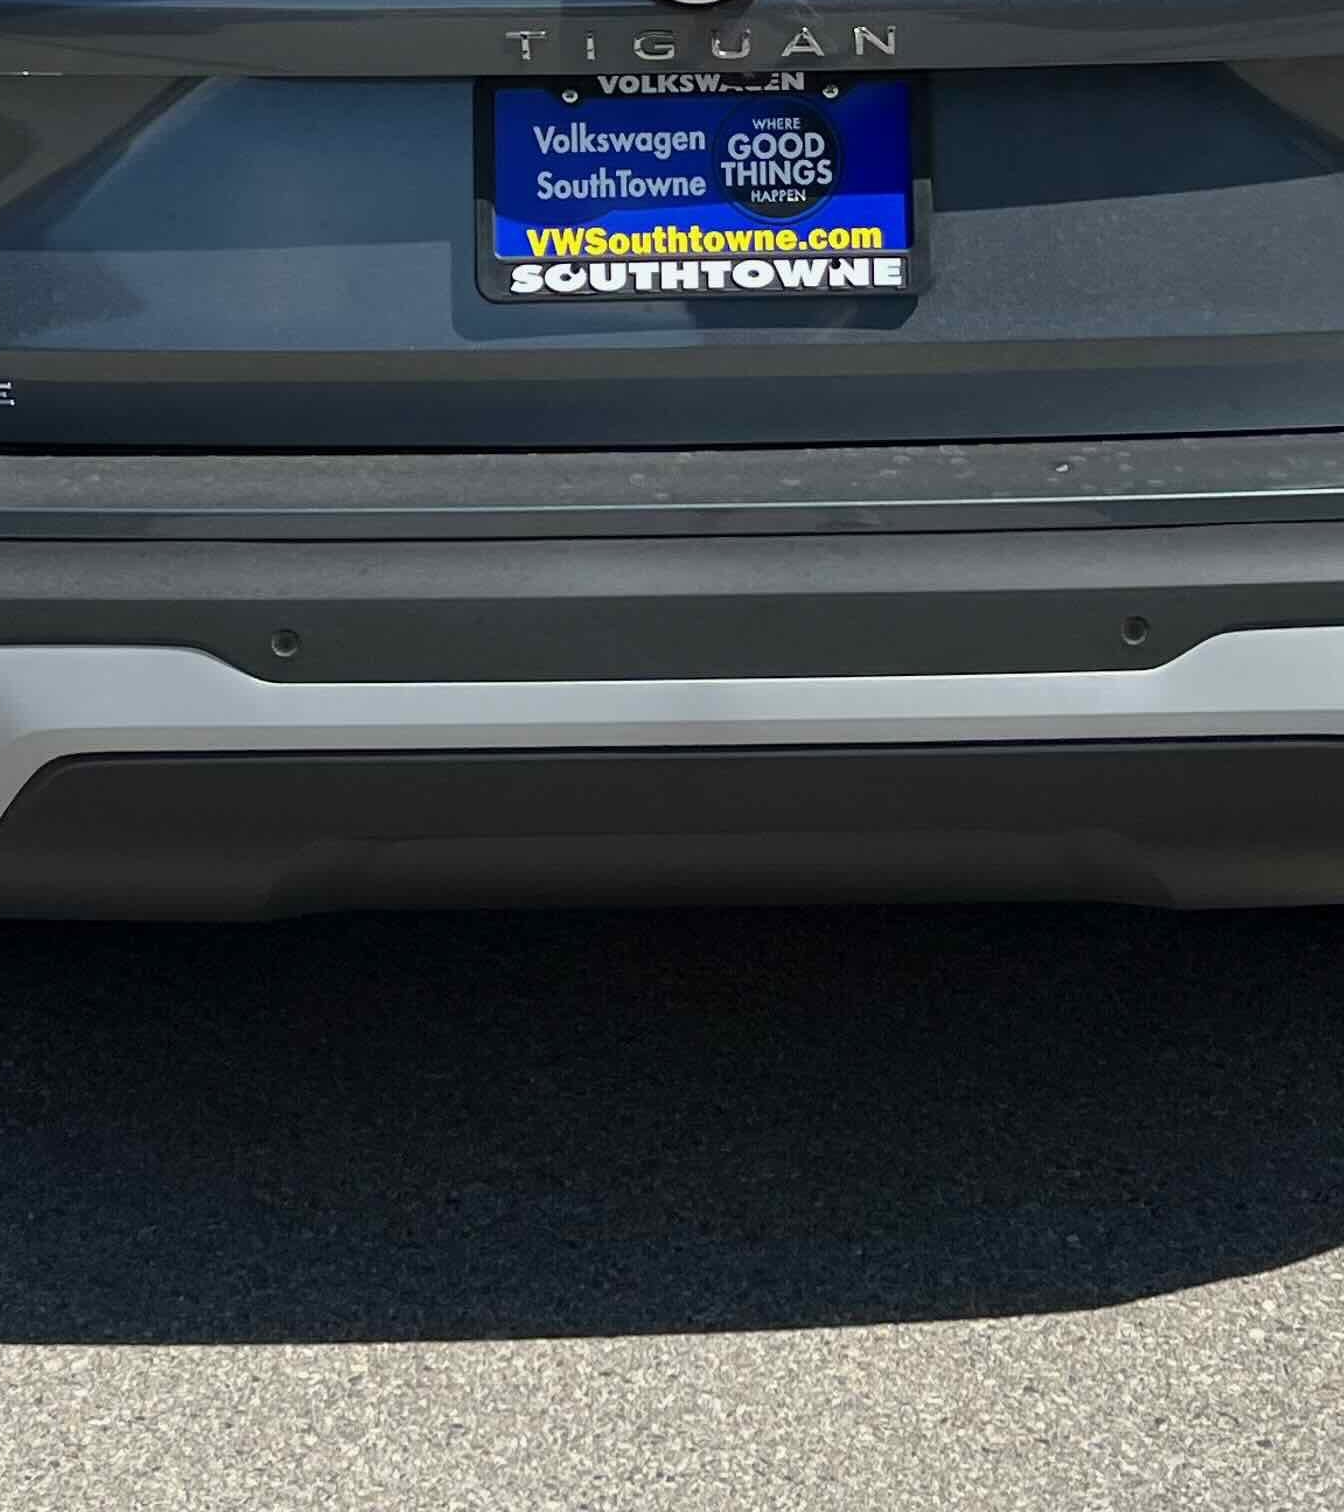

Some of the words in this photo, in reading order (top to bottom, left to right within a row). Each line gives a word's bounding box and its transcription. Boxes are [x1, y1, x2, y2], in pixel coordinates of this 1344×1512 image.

[505, 24, 897, 61] TIGUAN
[752, 117, 801, 130] WHERE
[533, 123, 706, 160] Volkswagen
[727, 132, 825, 161] GOOD
[536, 167, 707, 201] SouthTowne
[721, 159, 833, 187] THINGS
[751, 188, 807, 203] HAPPEN
[526, 224, 882, 258] VWSouthtowne.com
[510, 257, 903, 294] SOUTHTOWNE
